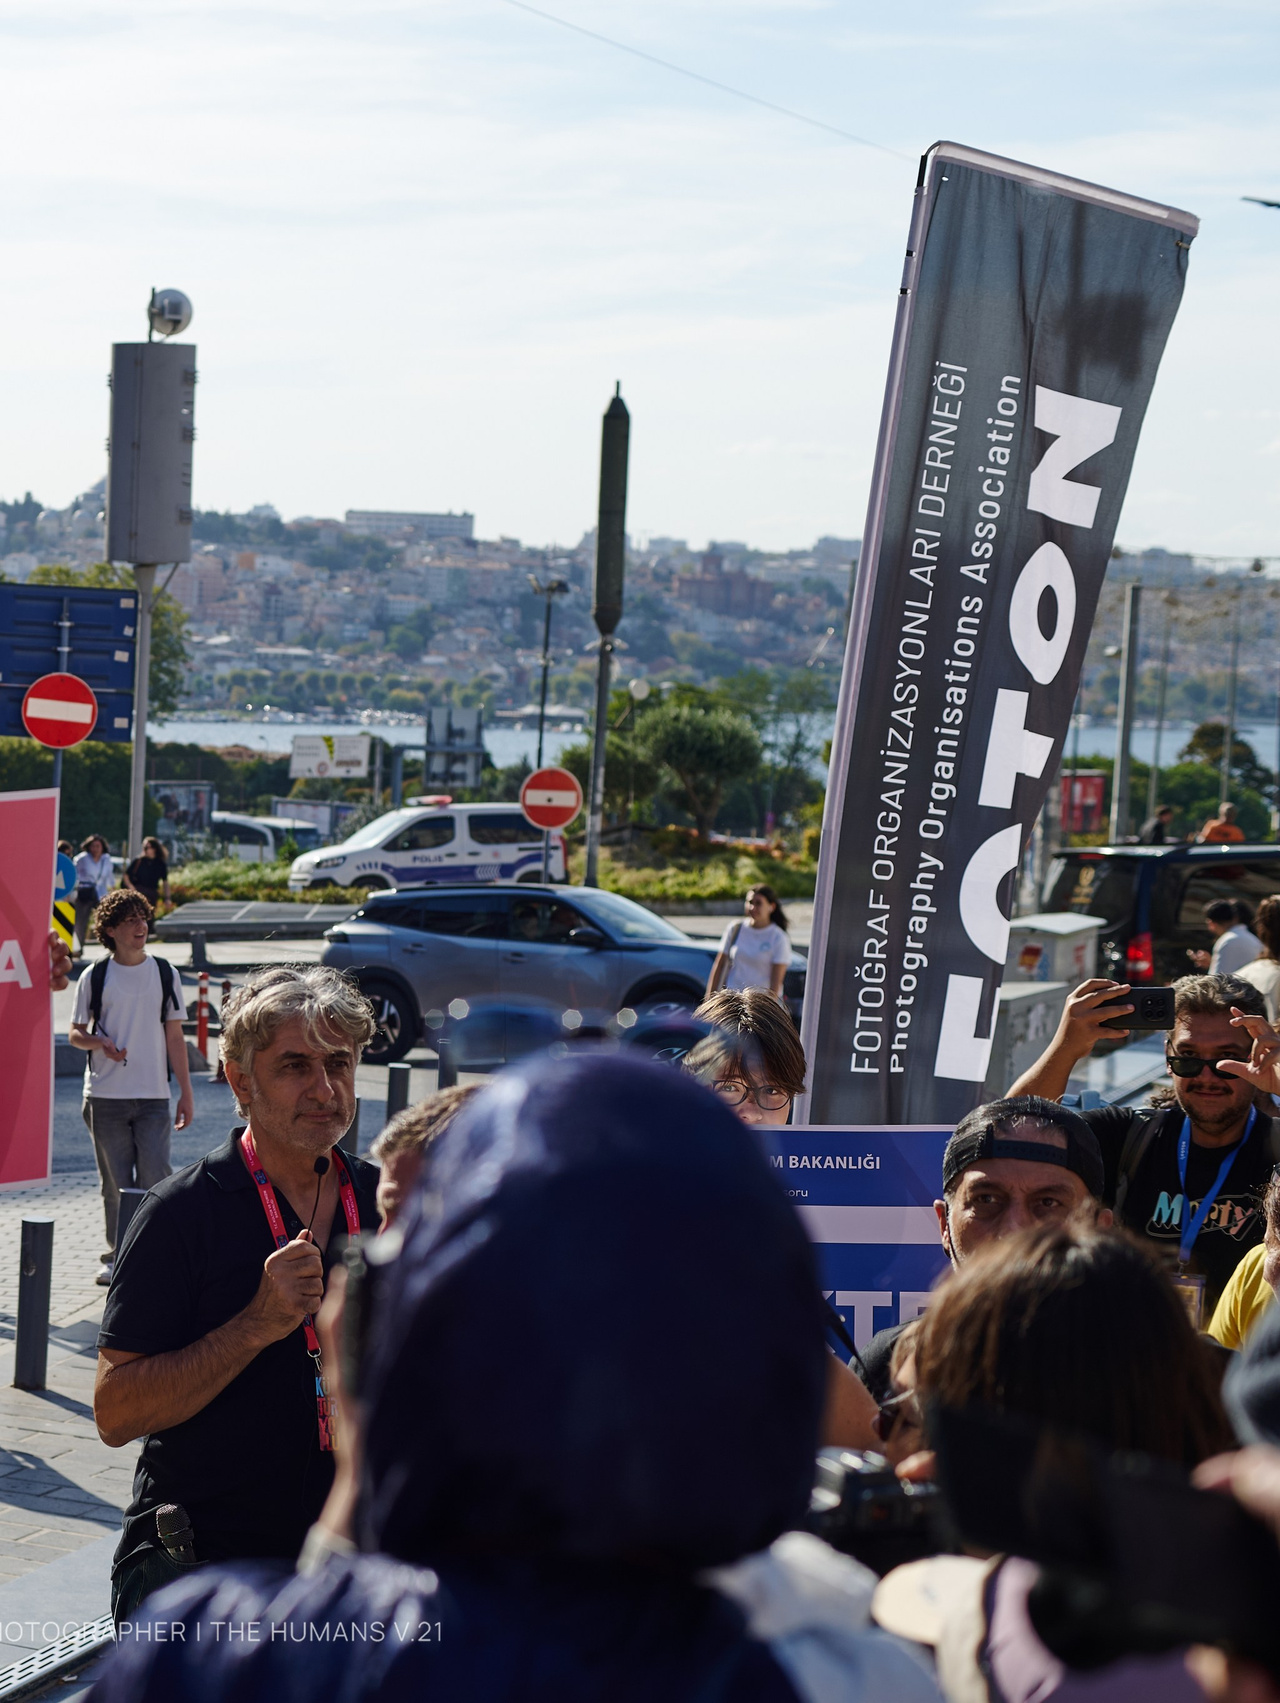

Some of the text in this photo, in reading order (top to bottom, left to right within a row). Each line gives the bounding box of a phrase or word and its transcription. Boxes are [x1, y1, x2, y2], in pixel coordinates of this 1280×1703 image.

[850, 360, 968, 1074] FOTOĞRAF ORGANİZASYONLARI DERNEĞİ
[889, 375, 1021, 1074] Photography Organisations Association
[788, 1154, 881, 1170] BAKANLIĞI
